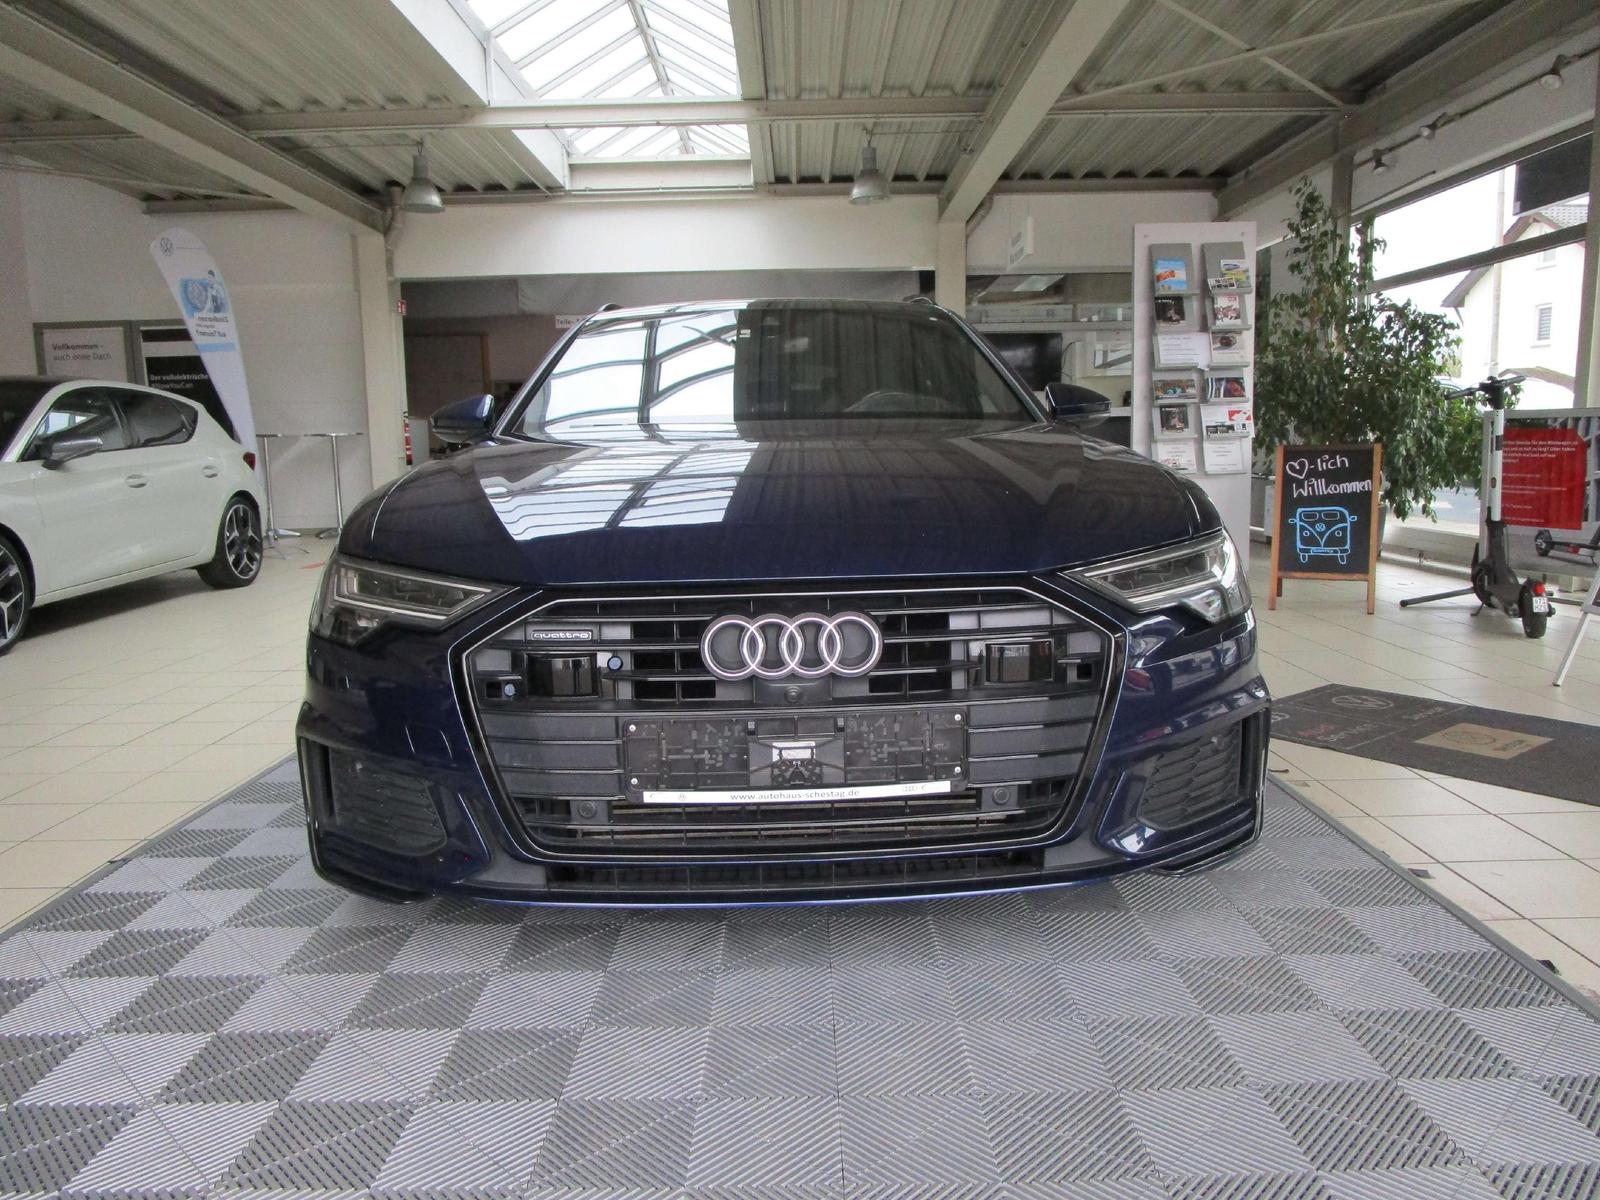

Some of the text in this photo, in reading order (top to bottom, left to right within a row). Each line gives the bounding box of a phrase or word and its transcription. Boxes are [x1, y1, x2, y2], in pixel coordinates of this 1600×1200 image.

[1293, 478, 1372, 498] Willkommen
[533, 632, 589, 640] quattro
[730, 788, 860, 801] www.autohaus-schestag.de
